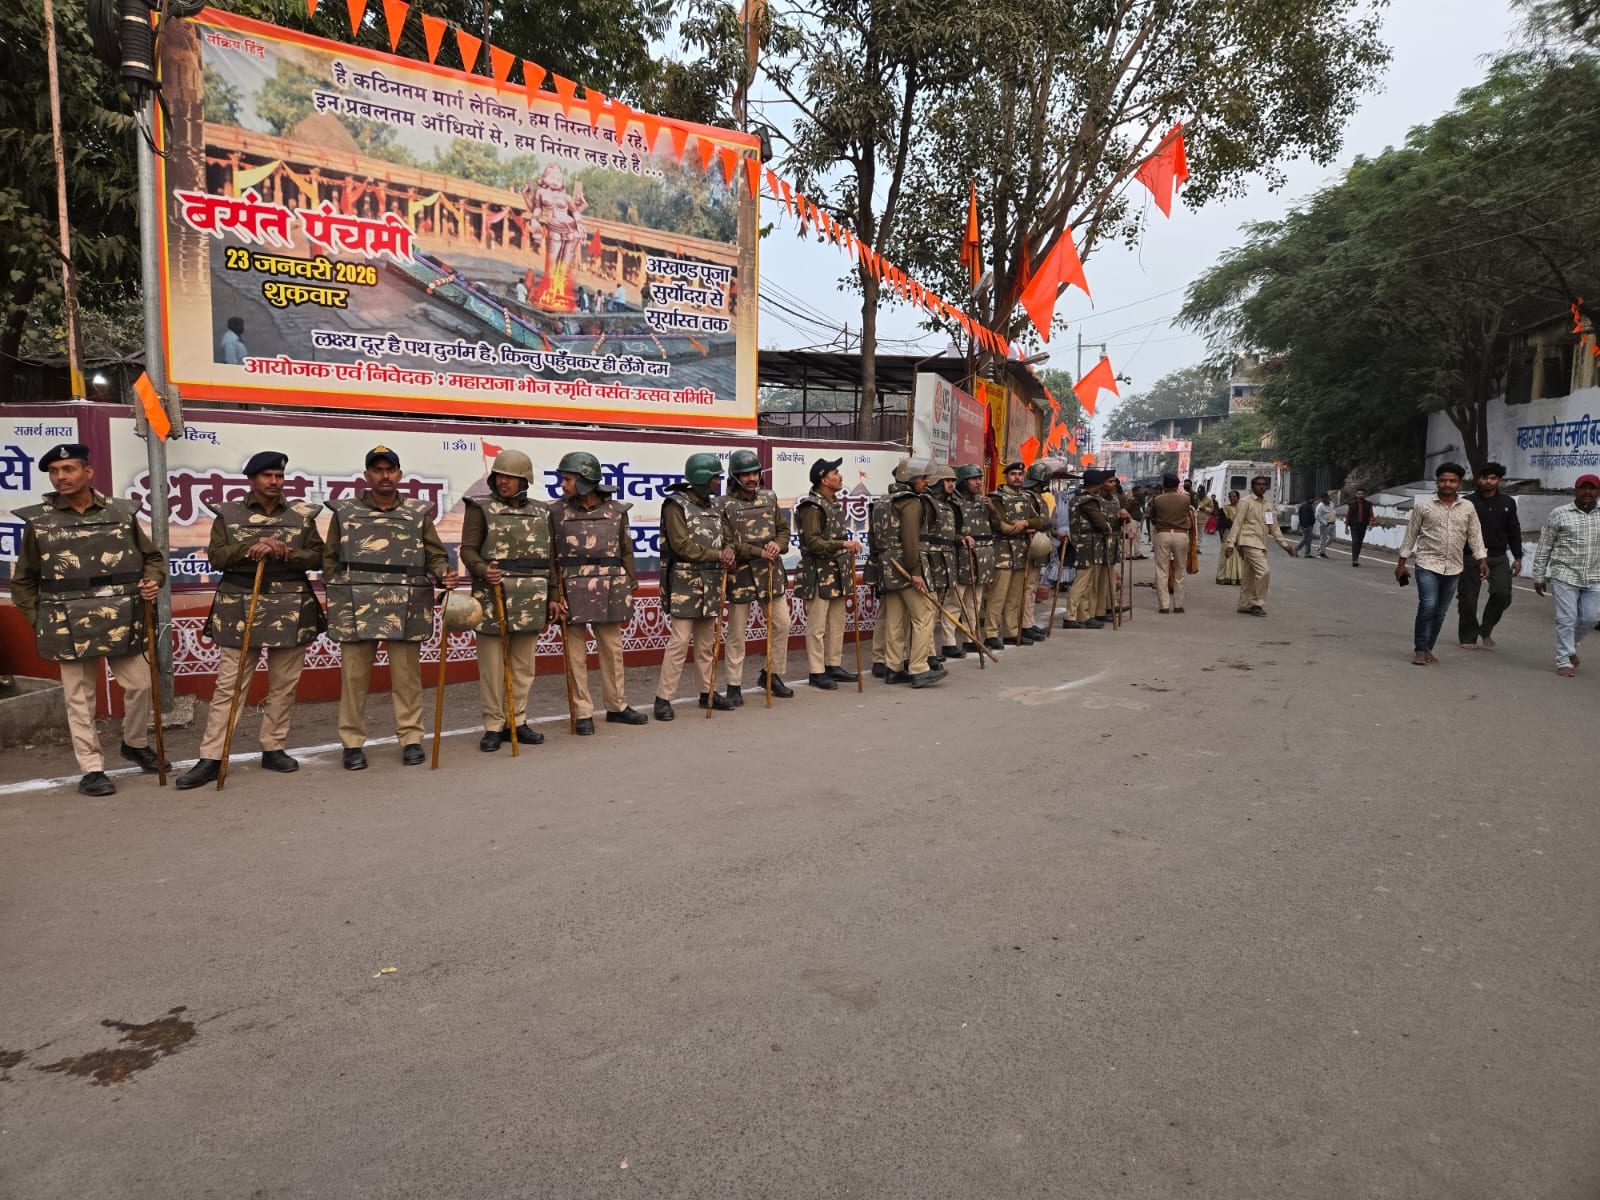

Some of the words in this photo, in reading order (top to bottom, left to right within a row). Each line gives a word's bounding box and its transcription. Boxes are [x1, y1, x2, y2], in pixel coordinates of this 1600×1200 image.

[334, 61, 347, 84] है
[352, 70, 427, 102] कठिनतम
[431, 89, 464, 110] मार्ग
[468, 93, 523, 126] लेकिन,
[528, 111, 550, 129] हम
[555, 113, 600, 140] निरन्तर
[602, 127, 623, 145] ब
[627, 129, 648, 152] रहे,
[314, 92, 340, 112] इन
[345, 98, 415, 126] प्रबलतम
[421, 111, 485, 140] आँधियों
[489, 123, 509, 148] से,
[514, 133, 536, 151] हम
[540, 134, 580, 160] निरंतर
[584, 148, 608, 167] लड़
[612, 150, 628, 170] रहे
[631, 152, 641, 172] है
[299, 201, 414, 260] पंचमी
[227, 248, 249, 270] 23
[254, 254, 332, 281] जनवरी
[336, 262, 376, 285] 2026
[646, 258, 699, 279] अखण्ड
[701, 265, 730, 286] पूजा
[264, 282, 348, 307] शुक्रवार
[710, 289, 724, 306] से
[646, 308, 700, 331] सूर्यास्त
[701, 316, 729, 331] तक
[314, 332, 357, 349] लक्ष्य
[360, 336, 385, 355] दूर
[388, 335, 401, 353] है
[404, 340, 431, 355] पथ
[434, 341, 476, 361] दुर्गम
[479, 343, 497, 364] है,
[501, 345, 541, 369] किन्तु
[545, 350, 600, 372] पहुँचकर
[602, 356, 616, 373] ही
[619, 356, 645, 374] लेंगे
[648, 363, 670, 376] दम
[244, 356, 330, 378] आयोजक
[334, 362, 362, 381] एवं
[366, 363, 434, 386] निवेदक
[448, 374, 514, 391] महाराजा
[517, 376, 551, 395] भोज
[554, 379, 592, 400] स्मृति
[596, 381, 631, 399] वसंत
[633, 388, 671, 402] उत्सव
[673, 387, 714, 405] समिति
[14, 423, 42, 437] समर्थ
[45, 426, 73, 437] भारत
[184, 427, 219, 445] हिन्दू
